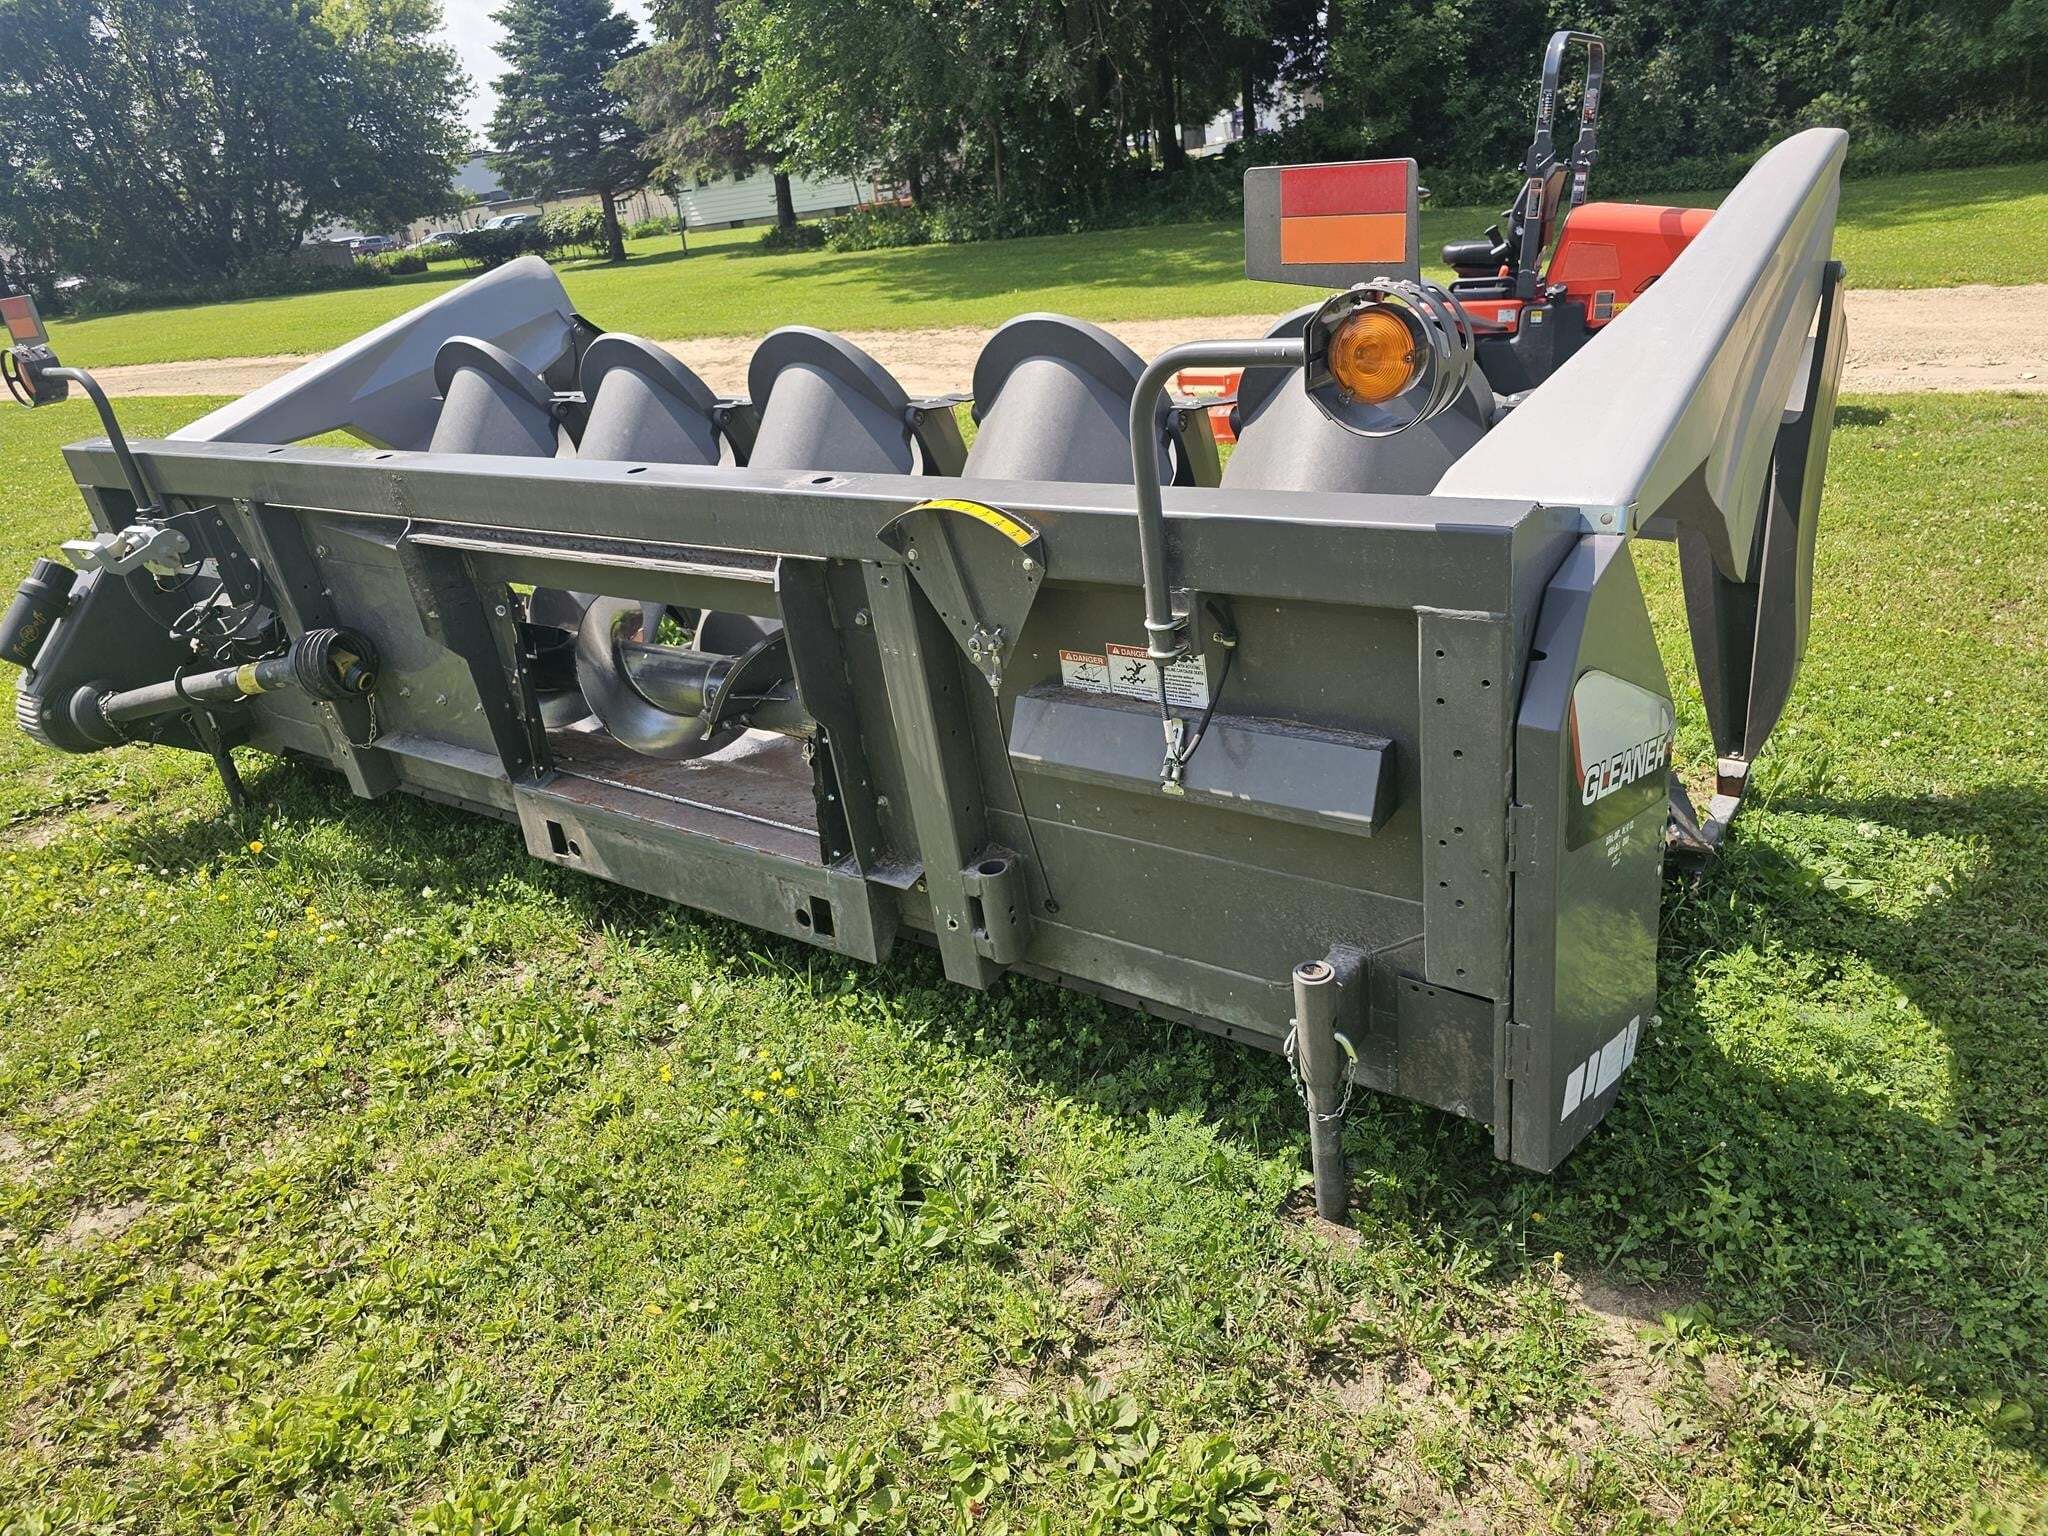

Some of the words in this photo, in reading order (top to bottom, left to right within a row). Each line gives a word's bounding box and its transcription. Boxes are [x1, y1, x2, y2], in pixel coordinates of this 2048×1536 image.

[1072, 653, 1104, 665] DANGER
[1121, 648, 1151, 658] DANGER
[1582, 732, 1668, 806] GLEANER
